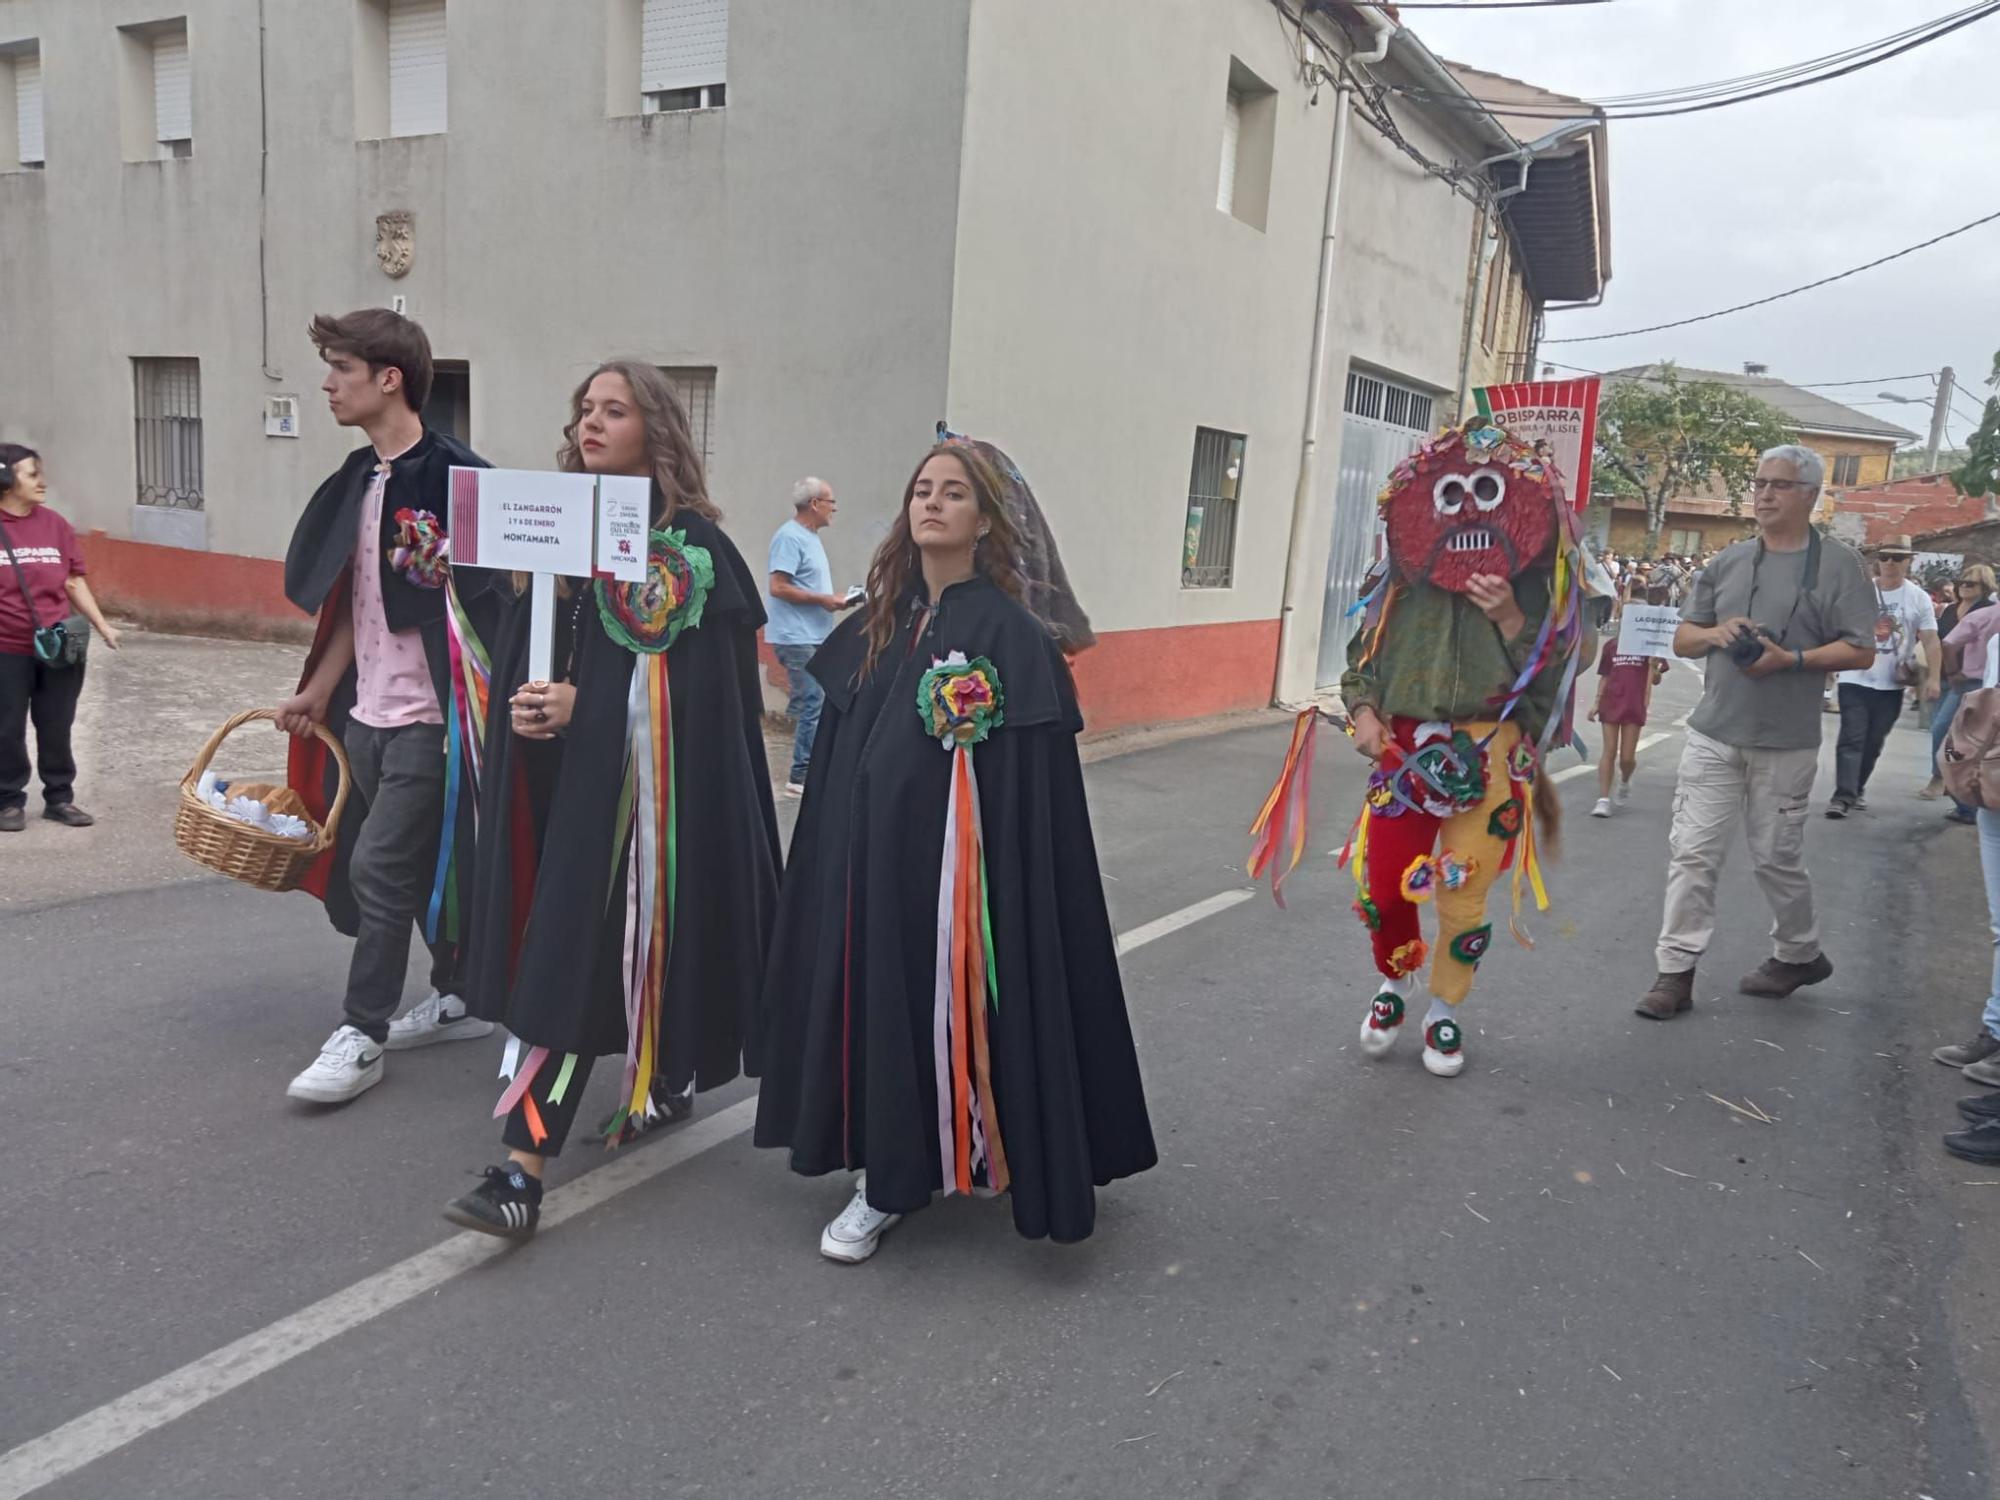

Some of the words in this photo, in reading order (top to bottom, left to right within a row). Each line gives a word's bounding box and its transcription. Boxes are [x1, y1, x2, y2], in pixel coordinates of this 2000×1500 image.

[1495, 410, 1581, 424] OBISPARRA
[1546, 423, 1580, 434] ALISTE
[503, 502, 511, 511] EL
[513, 517, 518, 525] Y
[524, 518, 532, 526] DE
[534, 519, 556, 528] ENERO
[504, 533, 560, 544] MONTAMARTA
